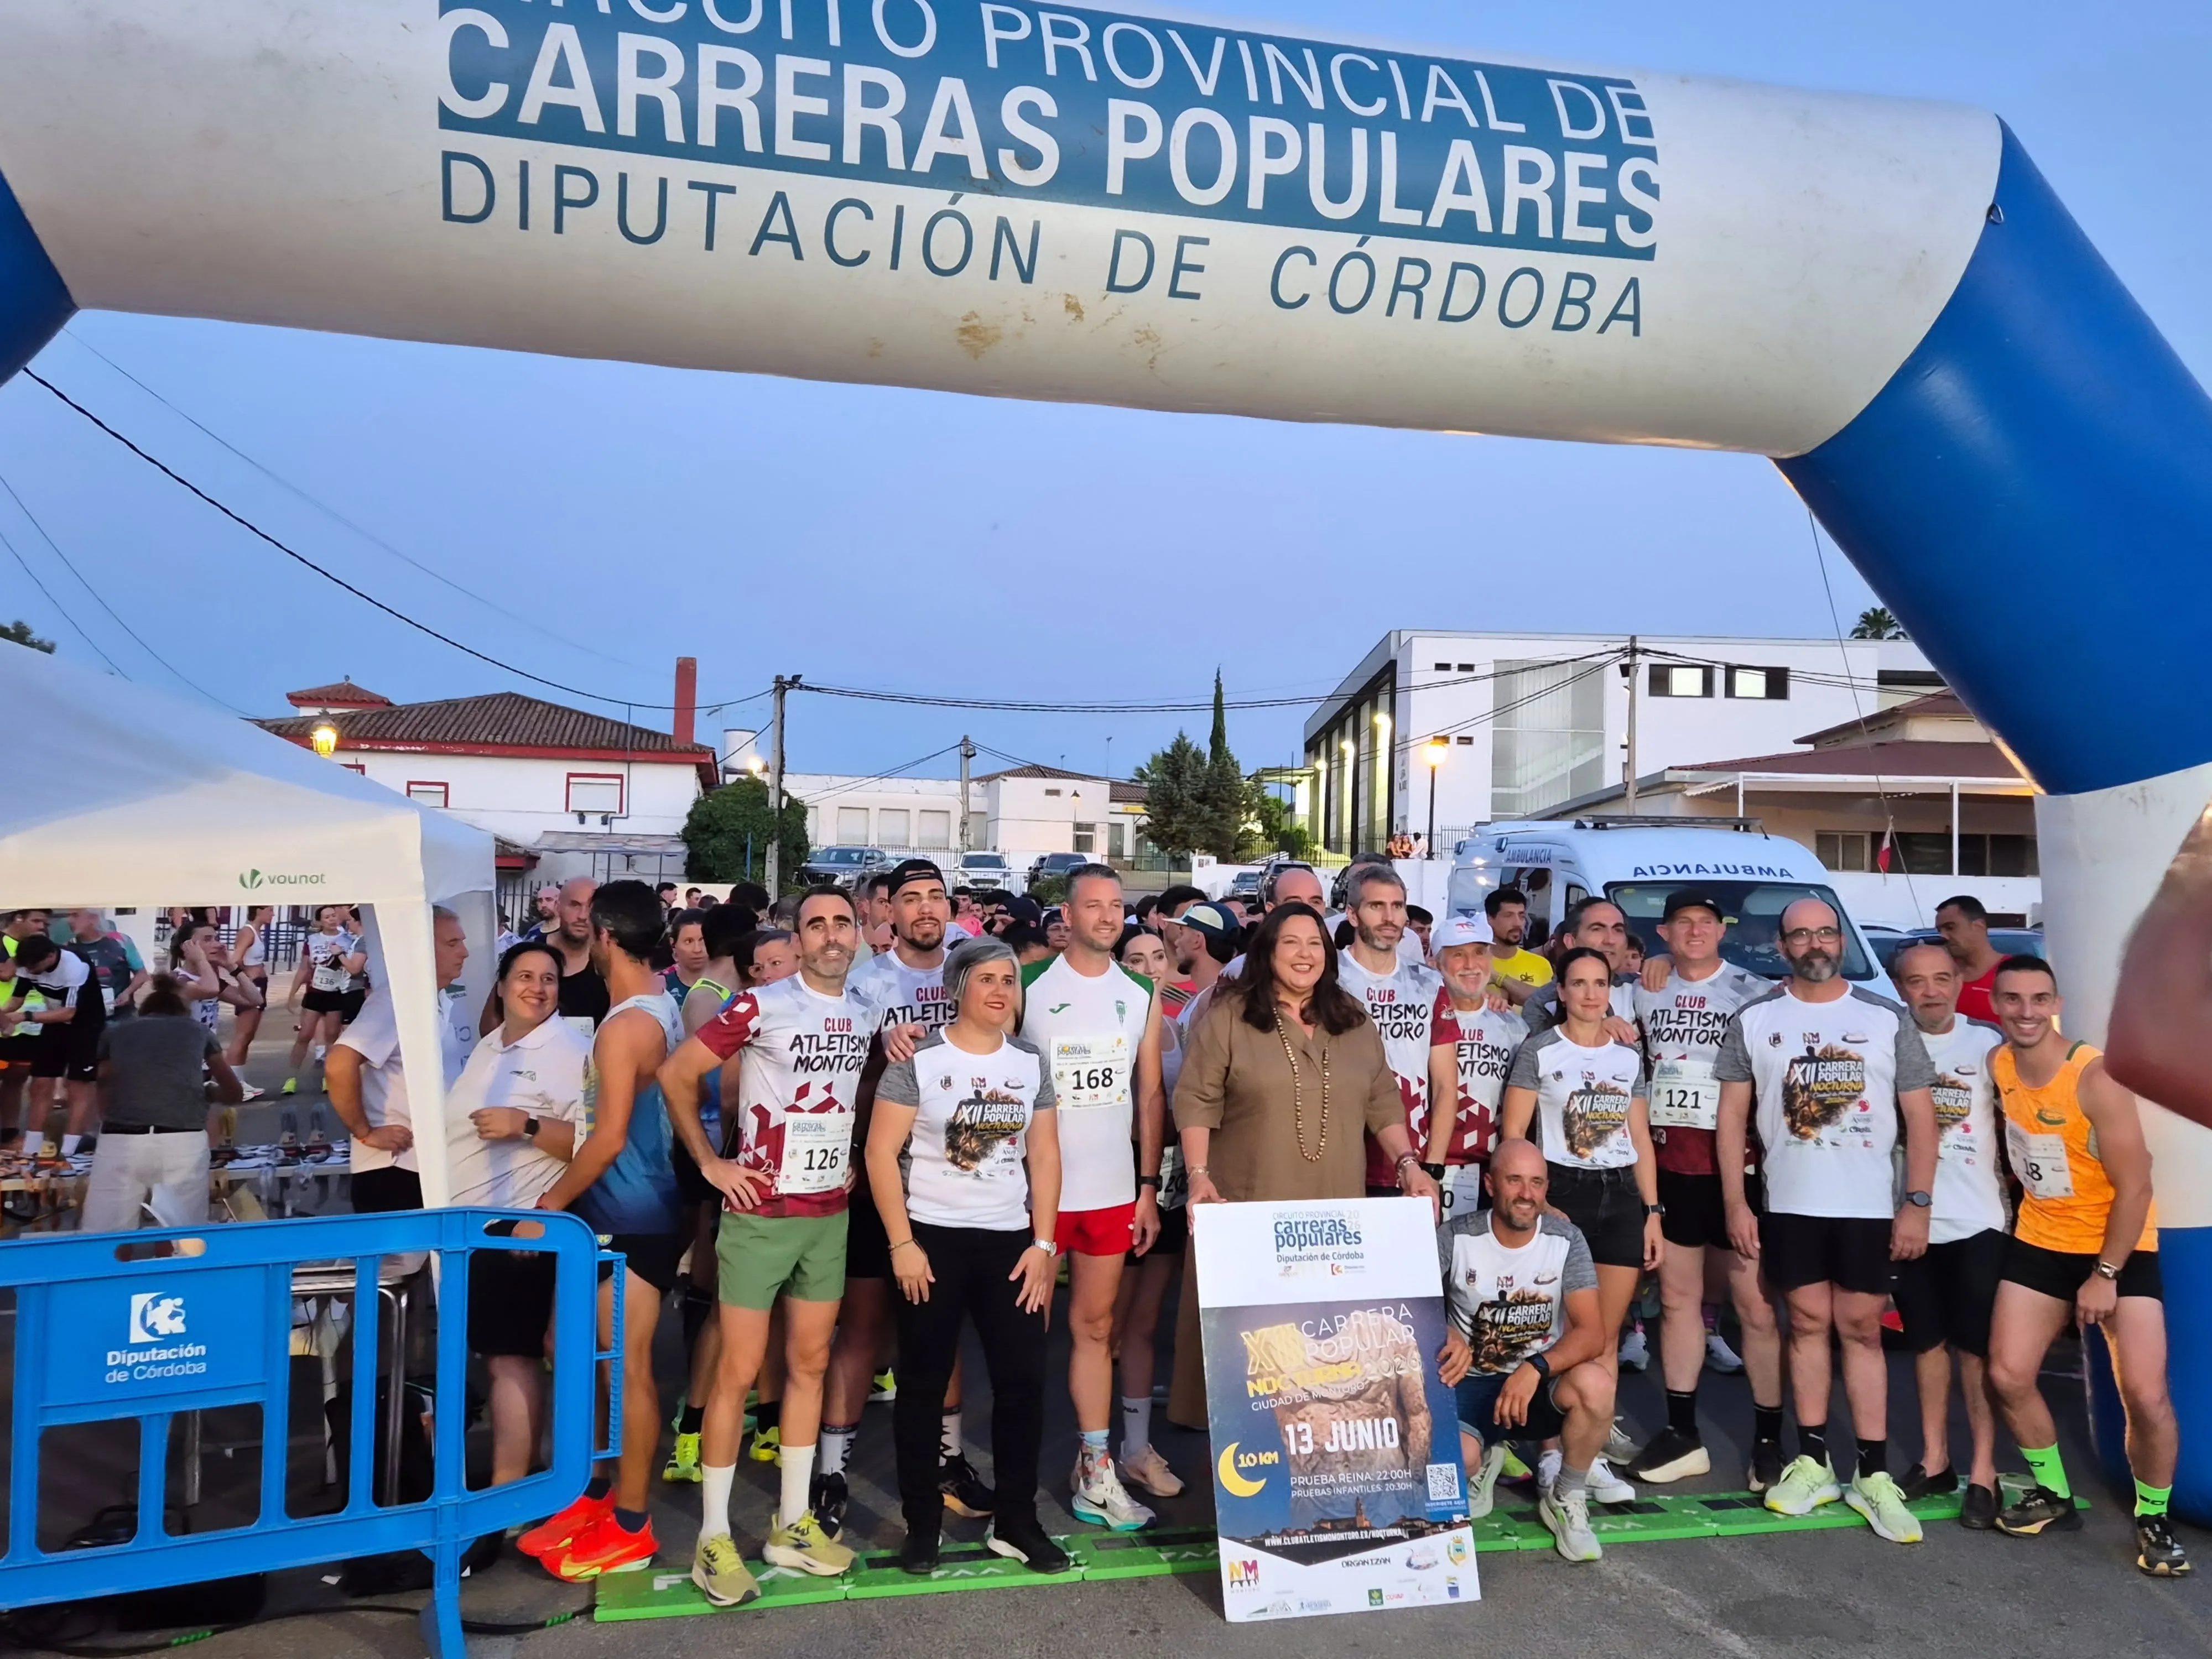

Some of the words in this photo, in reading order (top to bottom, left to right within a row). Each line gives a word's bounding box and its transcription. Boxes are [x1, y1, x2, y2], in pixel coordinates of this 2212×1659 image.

[981, 3, 1527, 133] PROVINCIAL
[1549, 78, 1656, 146] DE
[441, 9, 1059, 187] CARRERAS
[1106, 98, 1659, 248] POPULARES
[443, 149, 1041, 284] DIPUTACIÓN
[1106, 228, 1210, 300] DE
[1271, 235, 1642, 337] CÓRDOBA
[1505, 849, 1552, 863] AMBULANCIA
[268, 872, 326, 885] vounot
[319, 976, 335, 986] 136
[916, 986, 949, 1002] CLUB
[1367, 987, 1395, 1002] CLUB
[1675, 995, 1706, 1009] CLUB
[884, 1002, 959, 1026] ATLETIS
[1371, 1003, 1428, 1020] ETISMO
[824, 1017, 852, 1032] CLUB
[789, 1034, 872, 1052] ATLETISMO
[1461, 1029, 1484, 1041] LUB
[1459, 1042, 1510, 1062] ETISMO
[1072, 1067, 1113, 1091] 168
[1789, 1062, 1817, 1087] XII
[1818, 1060, 1863, 1072] CARRERA
[1818, 1072, 1862, 1082] POPULAR
[1809, 1082, 1864, 1092] NOCTURNA
[1931, 1088, 1971, 1099] CARRERA
[1569, 1094, 1593, 1115] XII
[1593, 1094, 1629, 1104] CARRERA
[1665, 1089, 1701, 1109] 121
[955, 1104, 983, 1126] XII
[983, 1104, 1024, 1114] CARRERA
[982, 1113, 1024, 1123] POPULAR
[974, 1121, 1023, 1130] NOCTURNA
[804, 1147, 839, 1171] 126
[1273, 1211, 1304, 1220] CIRCUITO
[1305, 1209, 1345, 1218] PROVINCIAL
[1346, 1209, 1359, 1219] 20
[1274, 1218, 1347, 1234] carreras
[1347, 1220, 1361, 1230] 26
[1276, 1229, 1362, 1253] populares
[1277, 1253, 1319, 1264] Diputación
[1320, 1252, 1330, 1261] de
[1332, 1251, 1364, 1260] Córdoba
[1302, 1303, 1413, 1338] CARRERA
[1481, 1306, 1507, 1324] XII
[1508, 1302, 1552, 1316] CARRERA
[1507, 1312, 1551, 1325] POPULAR
[1305, 1324, 1414, 1361] POPULAR
[106, 1342, 206, 1367] Diputación
[105, 1369, 128, 1383] de
[133, 1360, 206, 1380] Córdoba
[1364, 1351, 1423, 1381] 2026
[1251, 1396, 1293, 1411] CIUDAD
[1295, 1393, 1310, 1404] DE
[1311, 1381, 1365, 1400] MONTORO
[1285, 1423, 1313, 1455] 13
[1325, 1417, 1399, 1452] JUNIO
[1238, 1453, 1257, 1467] 10
[1258, 1451, 1279, 1465] KM
[1290, 1475, 1336, 1486] PRUEBA
[1376, 1469, 1412, 1480] 22:00H
[1291, 1488, 1332, 1498] PRUEBAS
[1229, 1559, 1259, 1580] NM
[1341, 1557, 1391, 1568] ORGANIZAN
